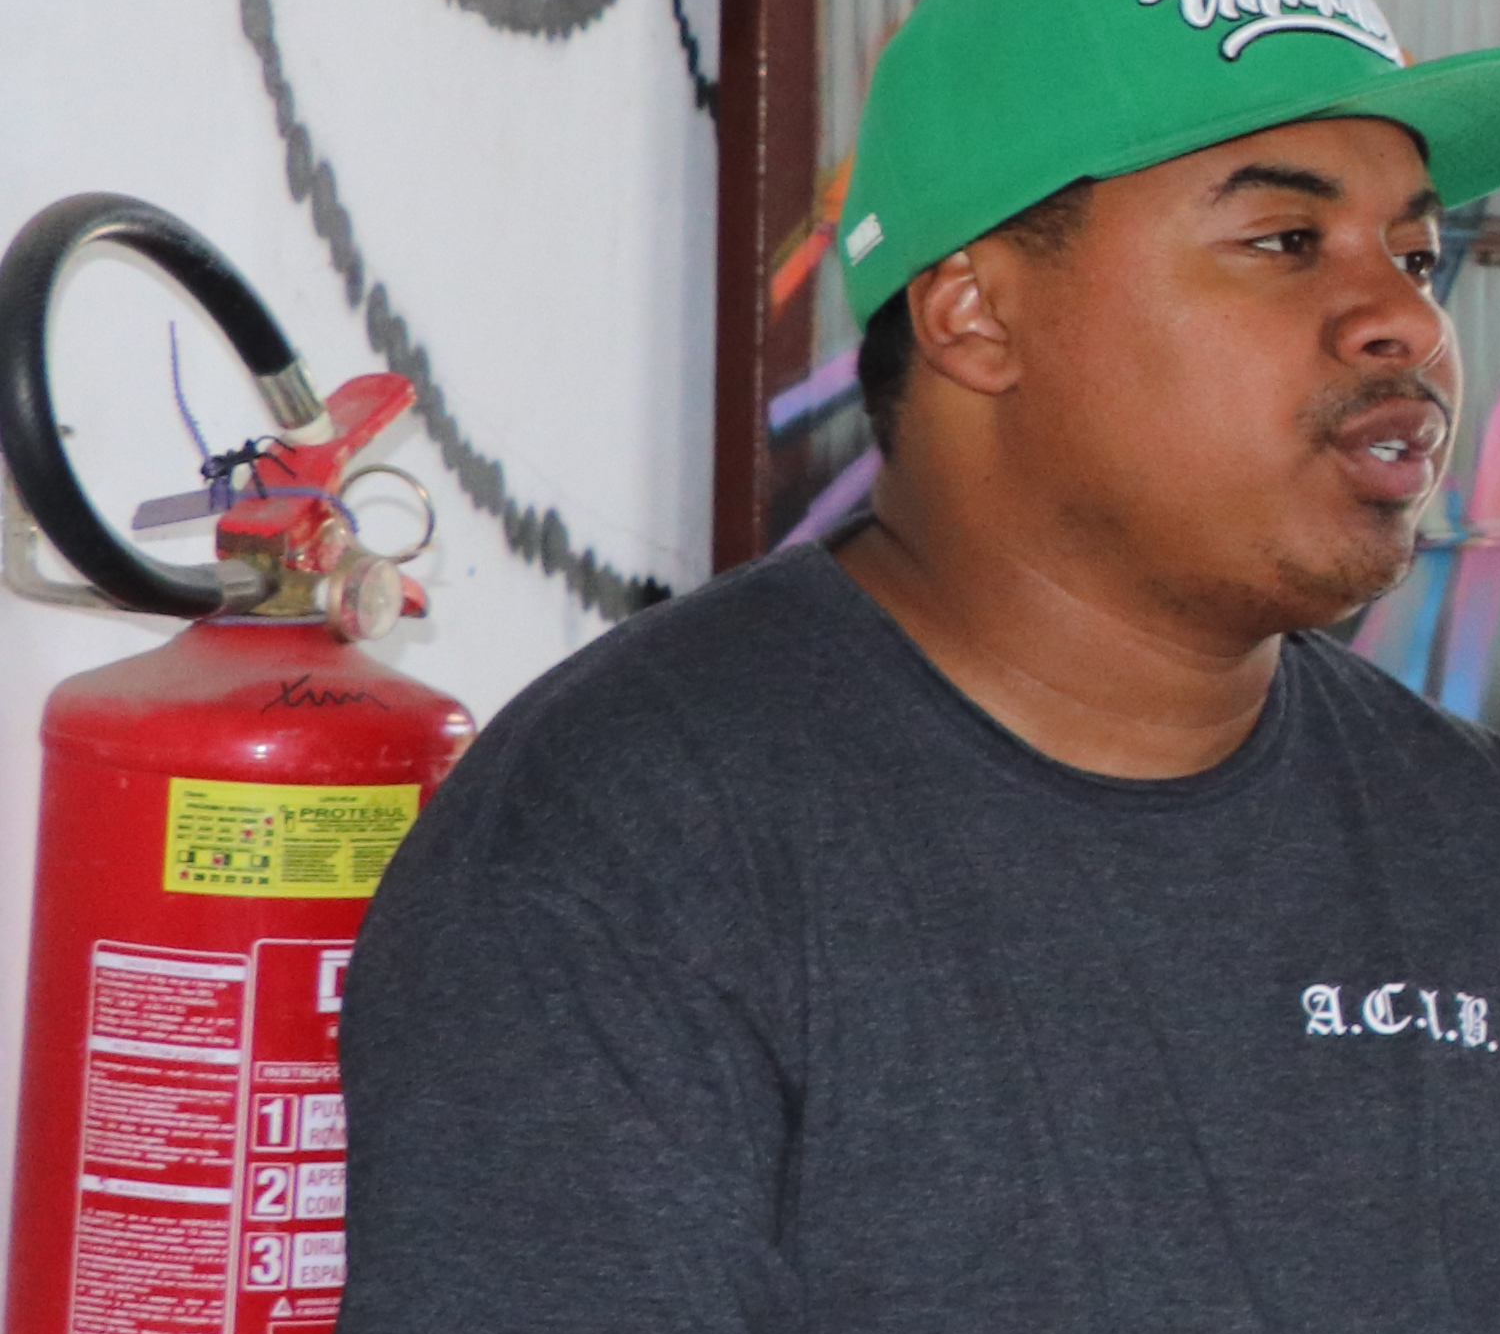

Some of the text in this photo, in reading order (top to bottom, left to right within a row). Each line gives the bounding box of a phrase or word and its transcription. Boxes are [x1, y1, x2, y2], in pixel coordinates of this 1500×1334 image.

[299, 806, 405, 819] PROTESUL
[259, 1098, 285, 1144] 1
[254, 1167, 287, 1215] 2
[250, 1236, 283, 1284] 3
